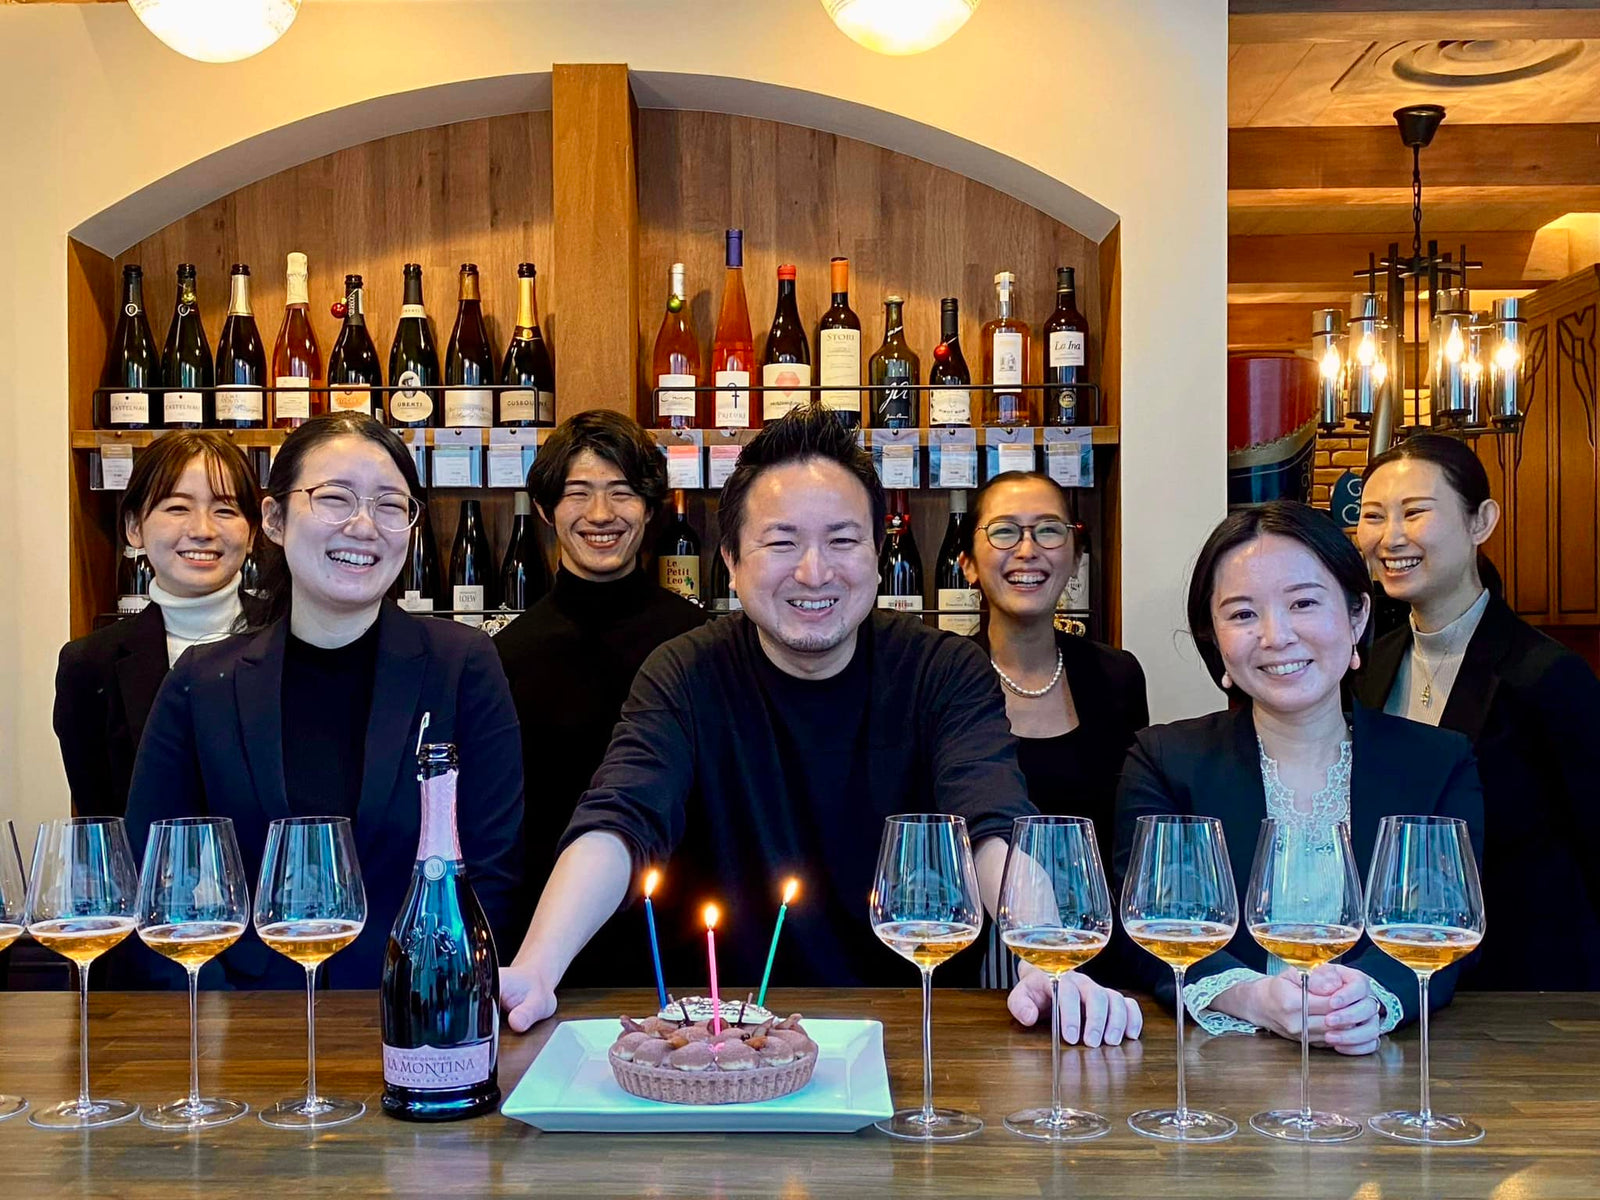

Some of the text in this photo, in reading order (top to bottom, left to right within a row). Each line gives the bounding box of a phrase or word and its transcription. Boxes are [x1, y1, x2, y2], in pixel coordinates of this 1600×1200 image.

[667, 559, 677, 567] Le
[387, 1057, 474, 1077] LA MONTINA
